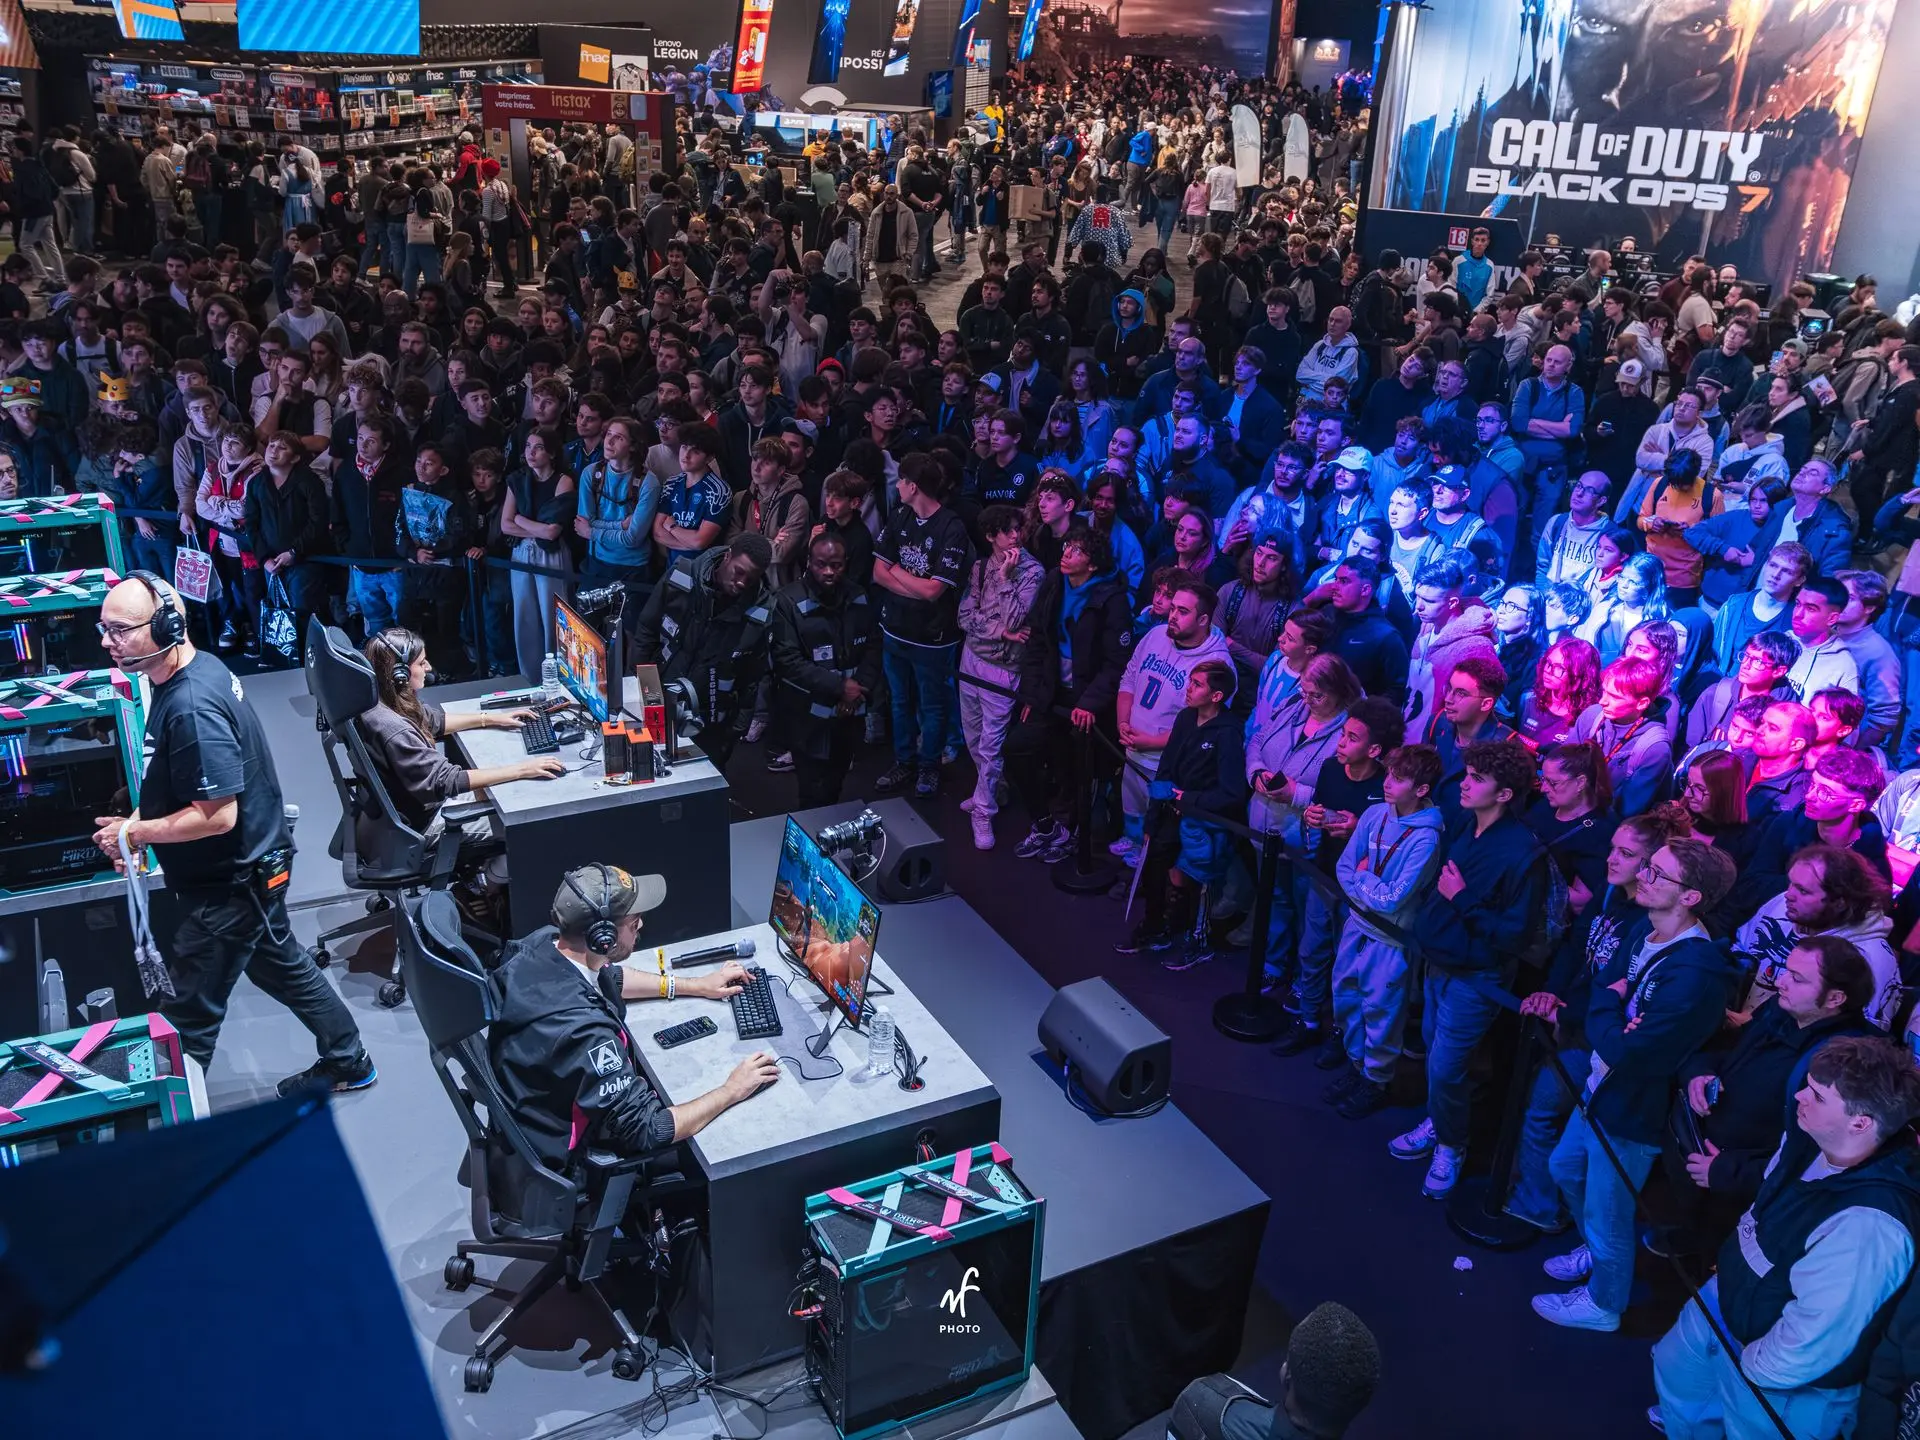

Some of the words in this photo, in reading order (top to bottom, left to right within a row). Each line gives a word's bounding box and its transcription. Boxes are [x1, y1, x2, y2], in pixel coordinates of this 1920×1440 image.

[653, 38, 682, 48] Lenovo
[580, 51, 610, 64] fnac
[653, 49, 698, 60] LEGION
[212, 70, 243, 80] Nintendo
[343, 74, 374, 83] PlayStation
[426, 70, 444, 81] fnac
[459, 68, 477, 78] fnac
[498, 91, 531, 101] Imprimez
[551, 92, 591, 109] instax
[513, 101, 536, 109] héros.
[1488, 118, 1600, 171] CALL
[1597, 133, 1630, 156] OF
[1626, 126, 1764, 182] DUTY
[1466, 167, 1624, 203] BLACK
[1626, 178, 1729, 211] OPS
[1737, 185, 1770, 213] 7
[1451, 229, 1467, 245] 18
